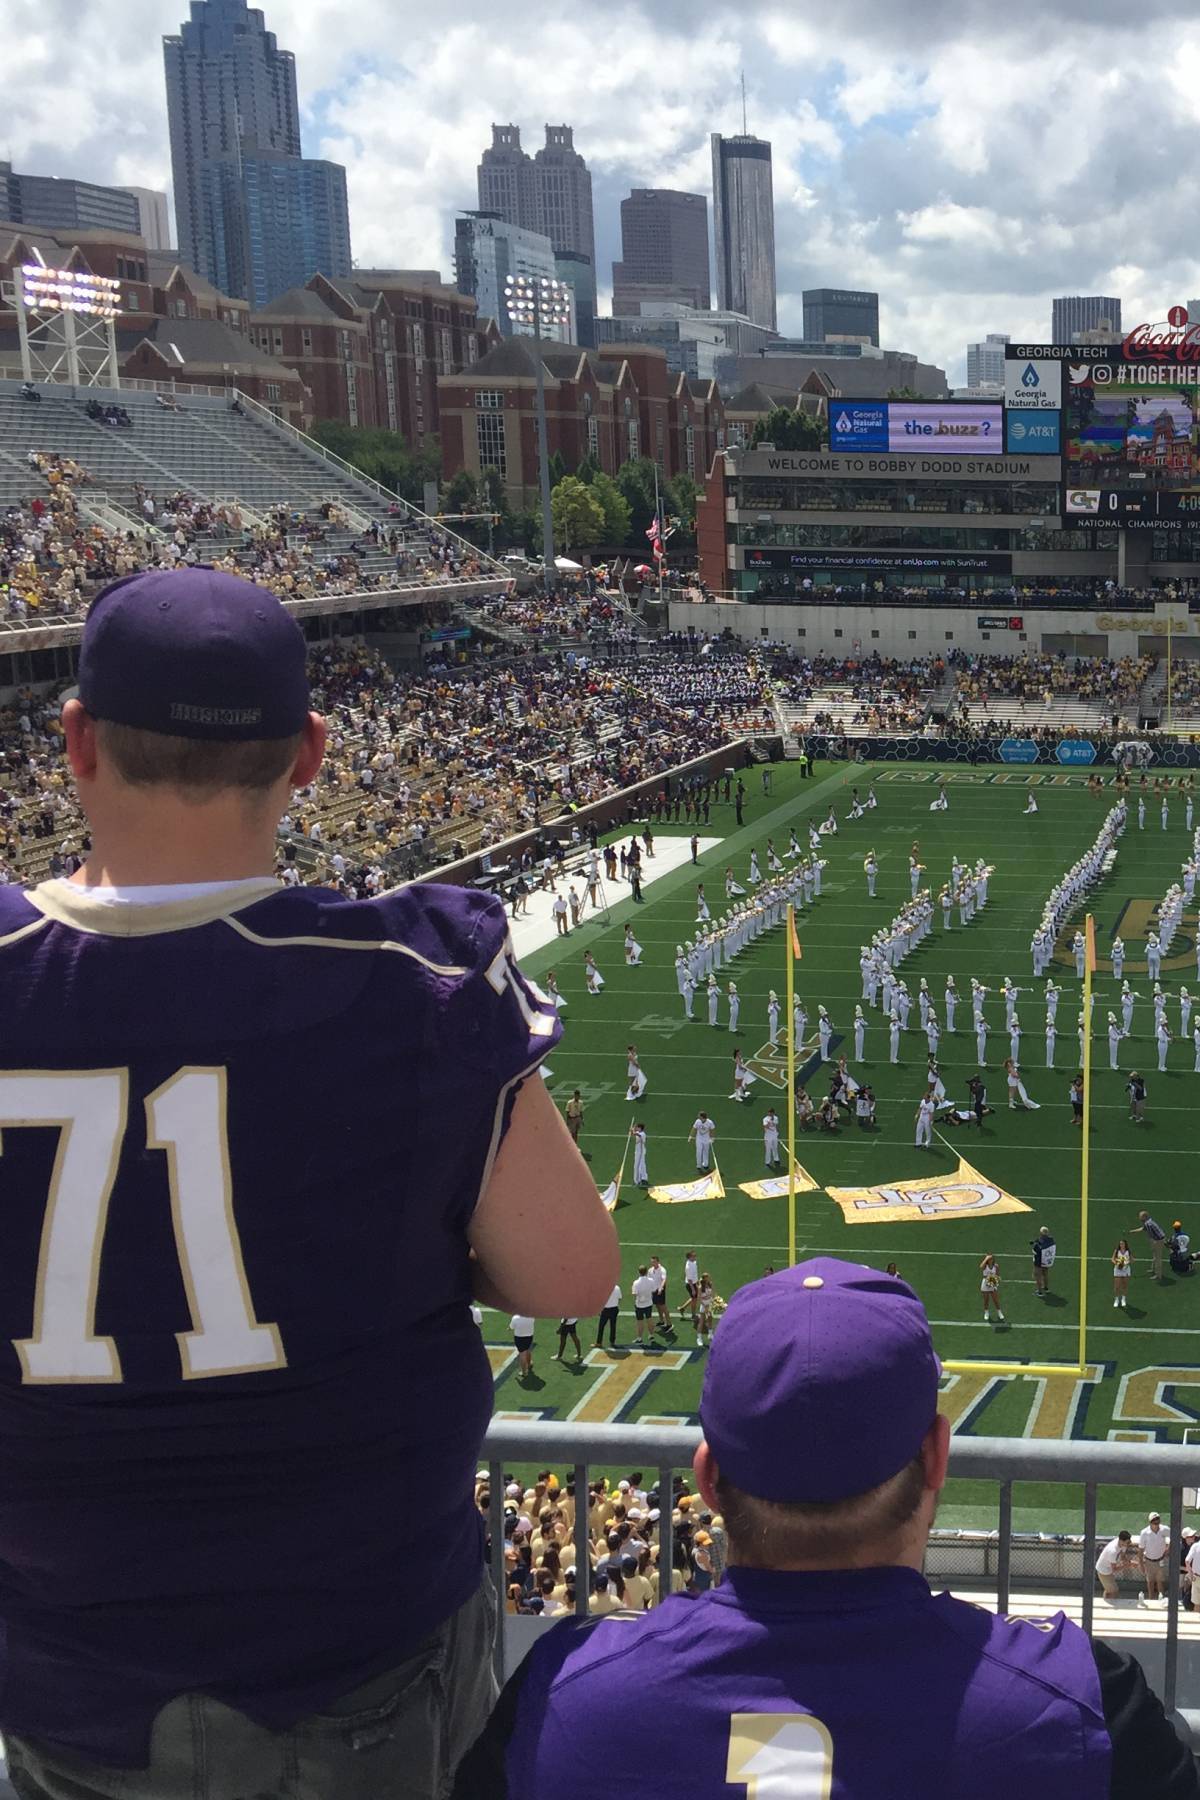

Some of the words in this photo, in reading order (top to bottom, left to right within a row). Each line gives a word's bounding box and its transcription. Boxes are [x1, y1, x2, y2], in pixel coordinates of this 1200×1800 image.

[1016, 346, 1072, 357] GEORGIA
[1076, 348, 1108, 358] TECH
[1014, 390, 1047, 399] Georgia
[852, 410, 884, 419] Georgia
[853, 426, 868, 434] Gas
[904, 420, 933, 435] the
[1028, 426, 1056, 437] AT&T
[768, 458, 840, 472] WELCOME
[844, 460, 864, 471] TO
[868, 460, 917, 472] BOBBY
[922, 461, 962, 474] DODD
[967, 462, 1031, 474] STADIUM
[1078, 520, 1122, 528] NATIONAL
[1128, 520, 1182, 529] CHAMPIONS
[808, 556, 822, 564] your
[825, 556, 854, 564] financial
[856, 557, 894, 566] confidence
[1096, 614, 1189, 635] Georgia
[1073, 750, 1092, 758] AT&T
[0, 1065, 288, 1386] 71
